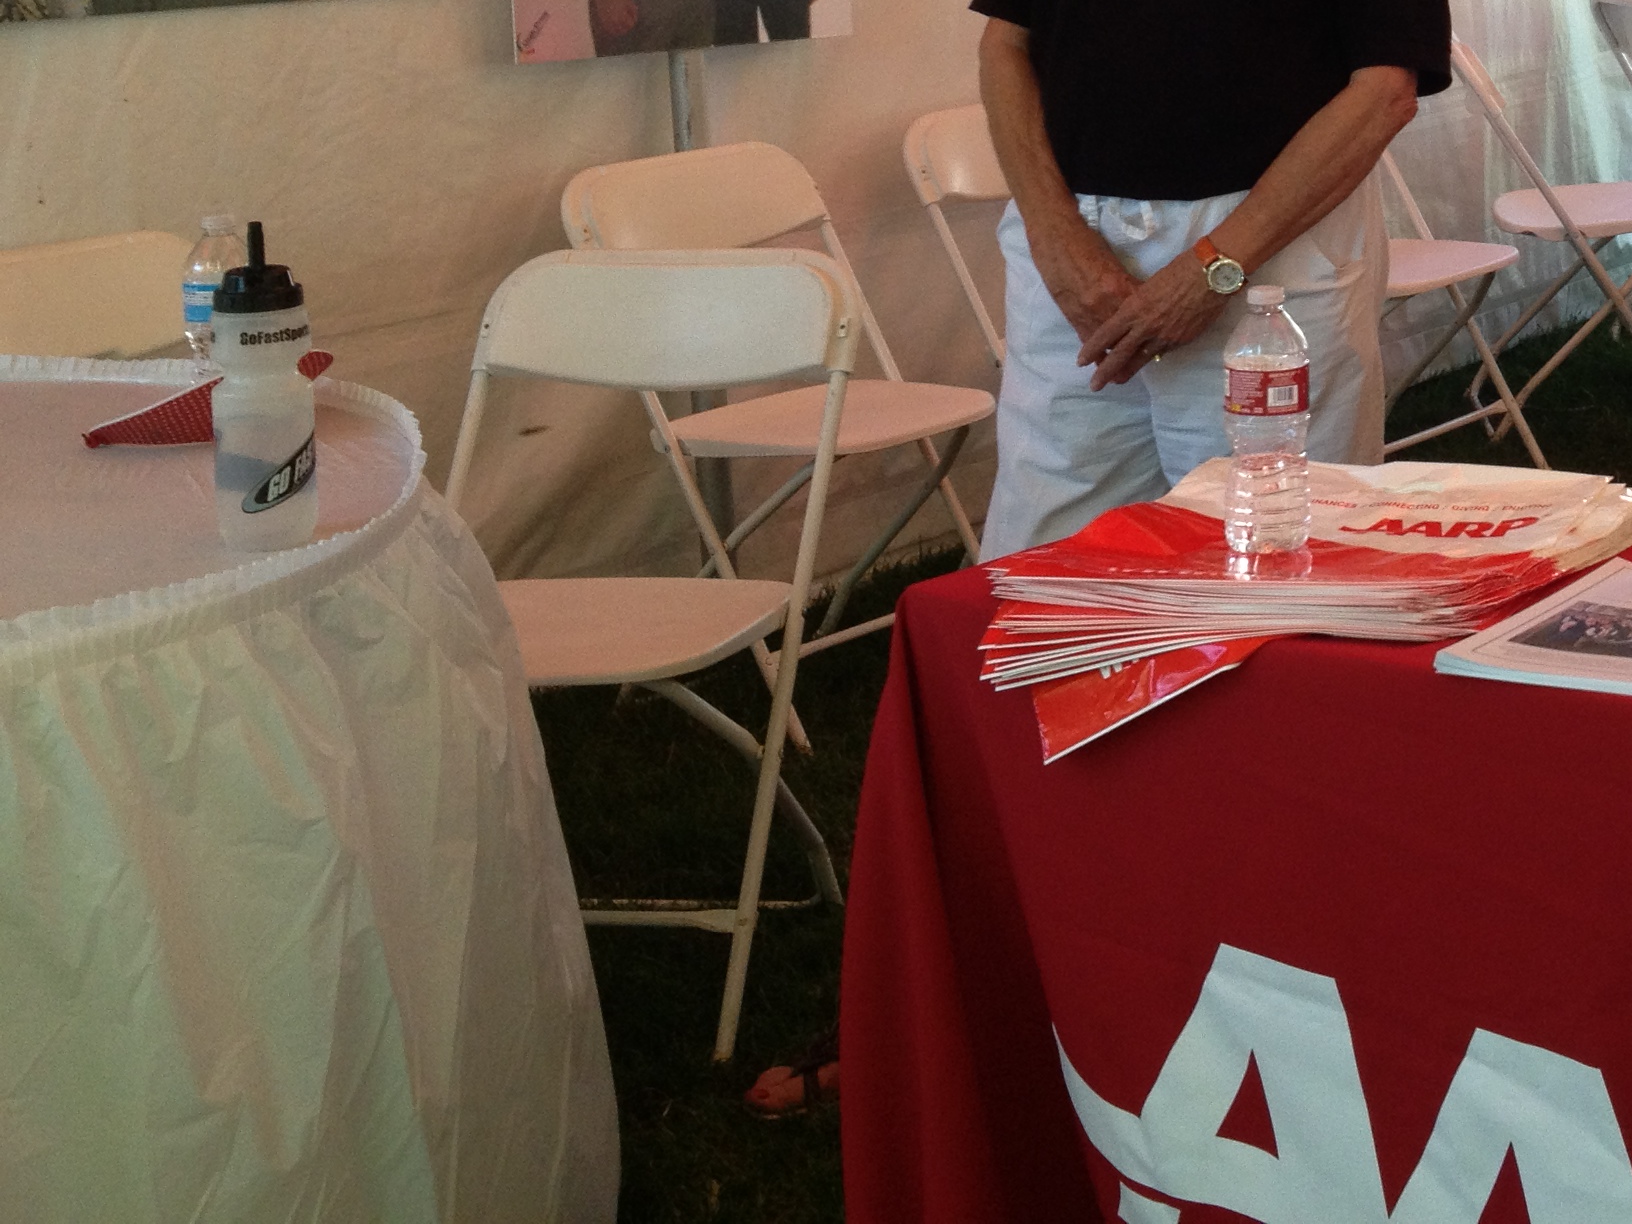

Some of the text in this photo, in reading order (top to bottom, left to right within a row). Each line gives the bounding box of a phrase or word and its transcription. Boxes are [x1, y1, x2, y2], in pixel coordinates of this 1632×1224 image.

[265, 465, 292, 502] GO
[1310, 498, 1358, 509] INANCES
[1339, 517, 1540, 538] AARP
